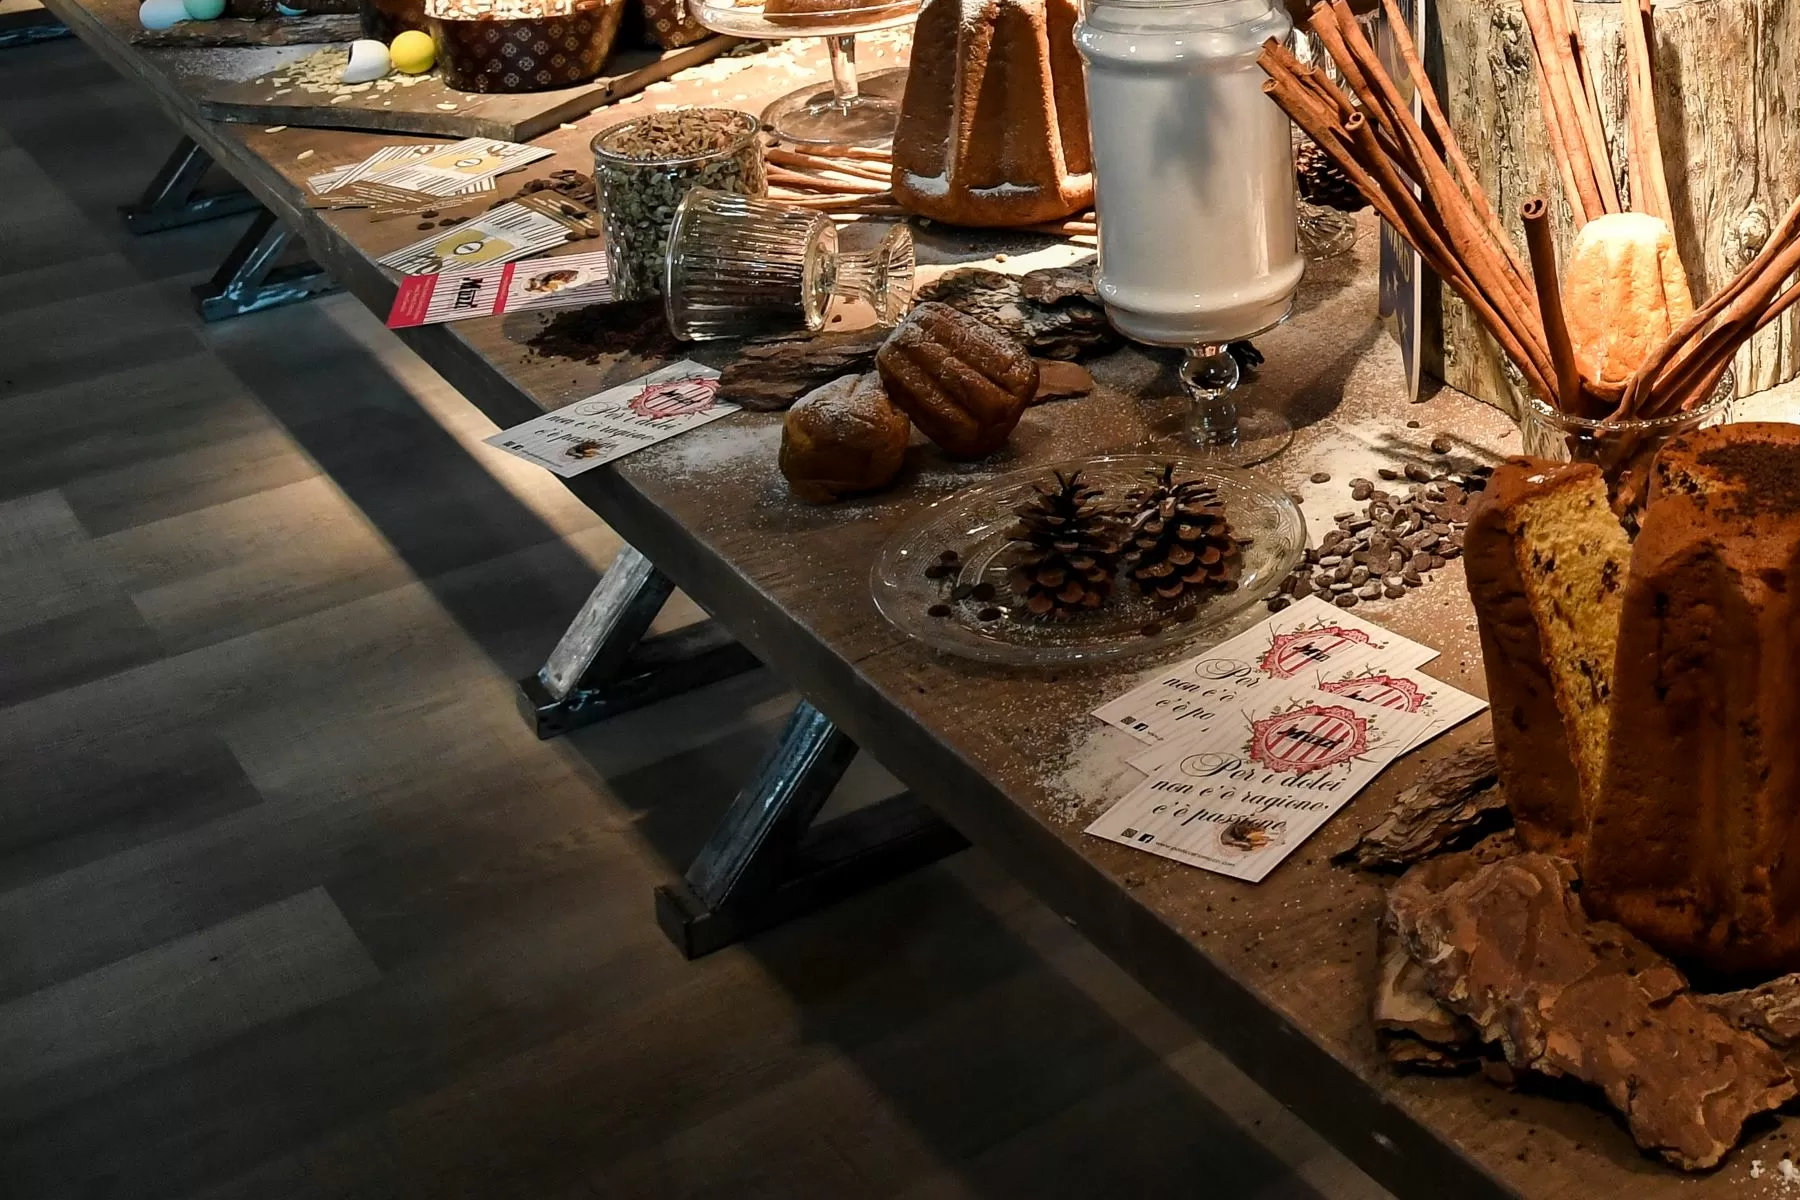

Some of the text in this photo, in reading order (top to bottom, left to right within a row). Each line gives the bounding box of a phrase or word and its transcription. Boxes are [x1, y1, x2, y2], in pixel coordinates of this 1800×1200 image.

[1162, 677, 1201, 693] non
[1180, 751, 1257, 782] Per
[1280, 770, 1347, 792] dolci
[1151, 778, 1194, 796] non
